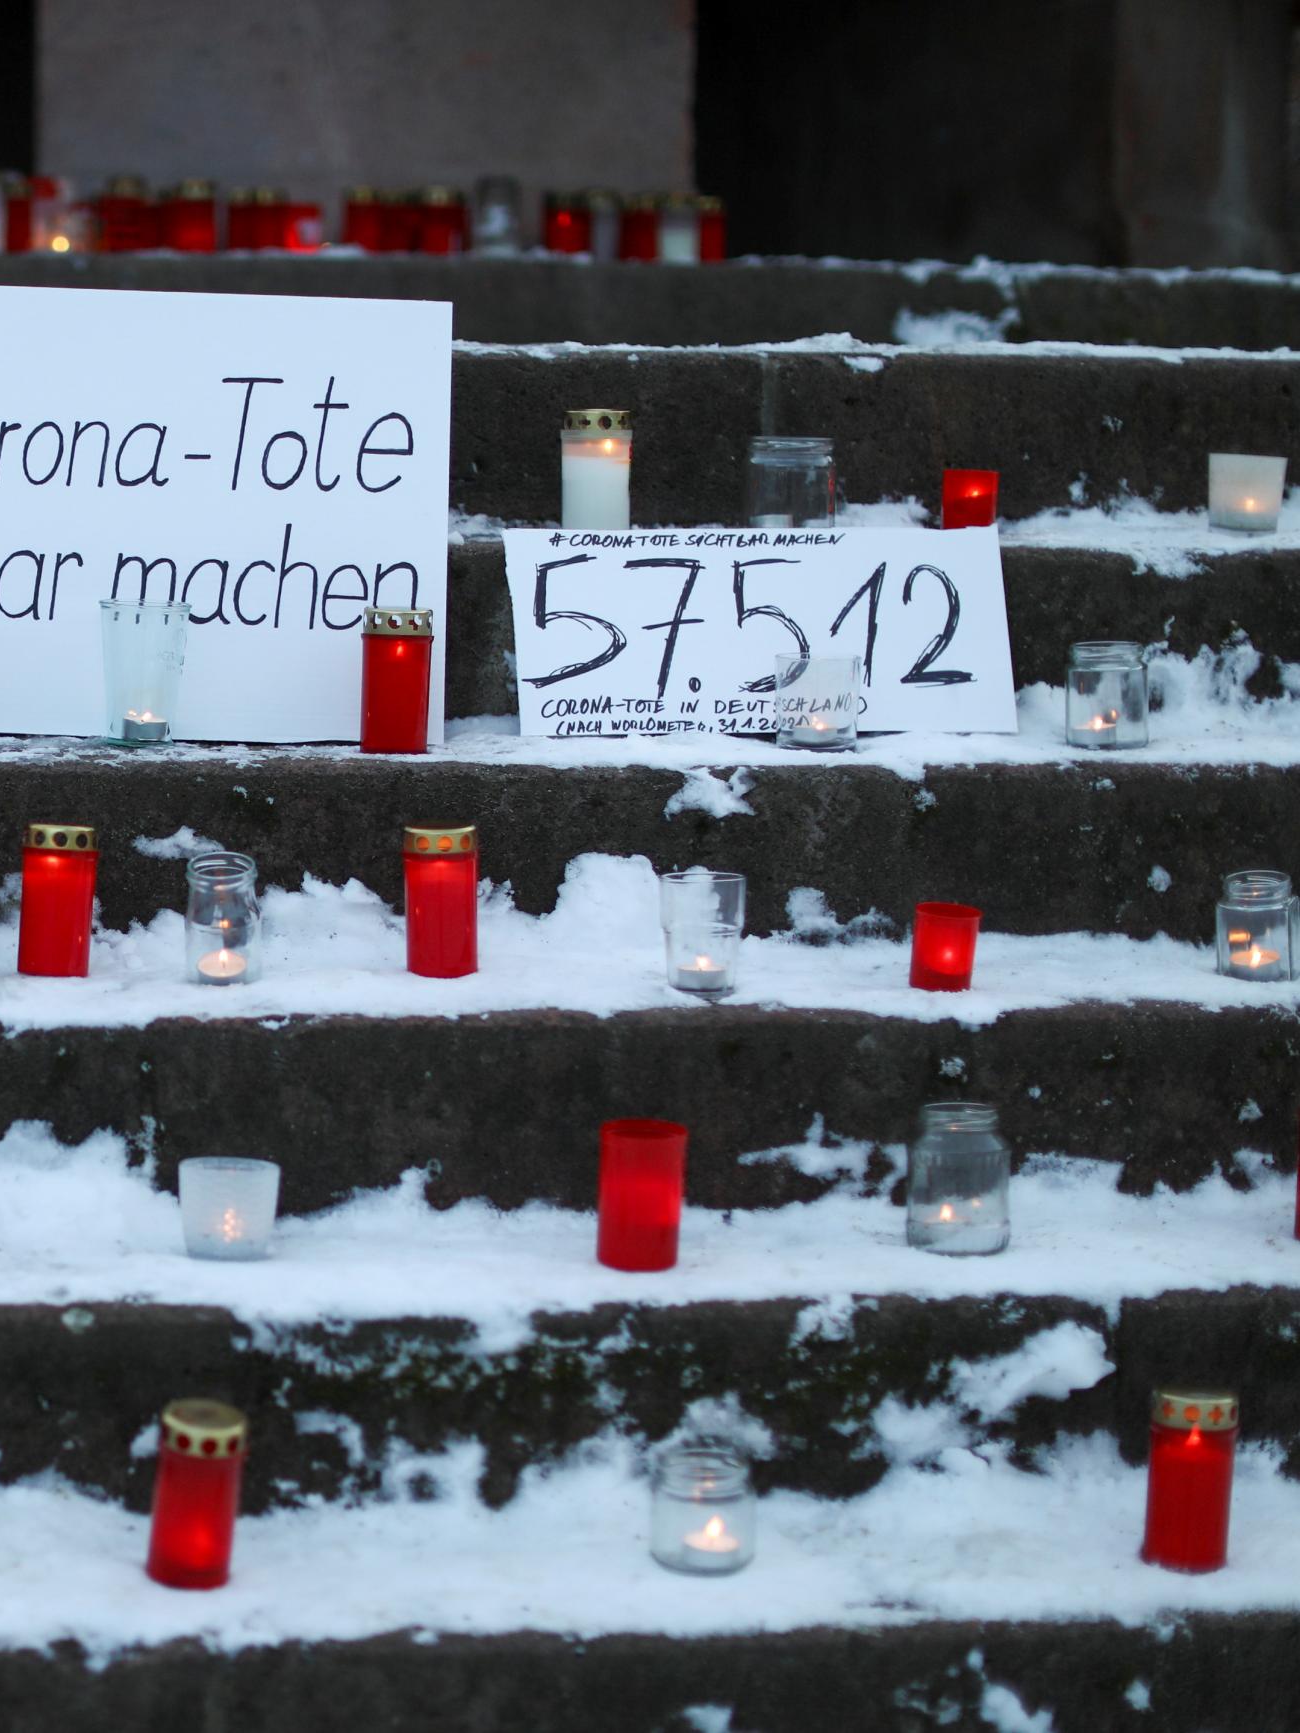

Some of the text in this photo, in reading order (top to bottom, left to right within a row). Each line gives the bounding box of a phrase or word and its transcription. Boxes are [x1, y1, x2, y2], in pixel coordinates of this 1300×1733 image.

[111, 523, 419, 631] machen
[521, 553, 978, 699] 57.512
[541, 695, 665, 719] CORONA-TOTE
[680, 699, 700, 713] IN
[555, 718, 602, 735] (NACH
